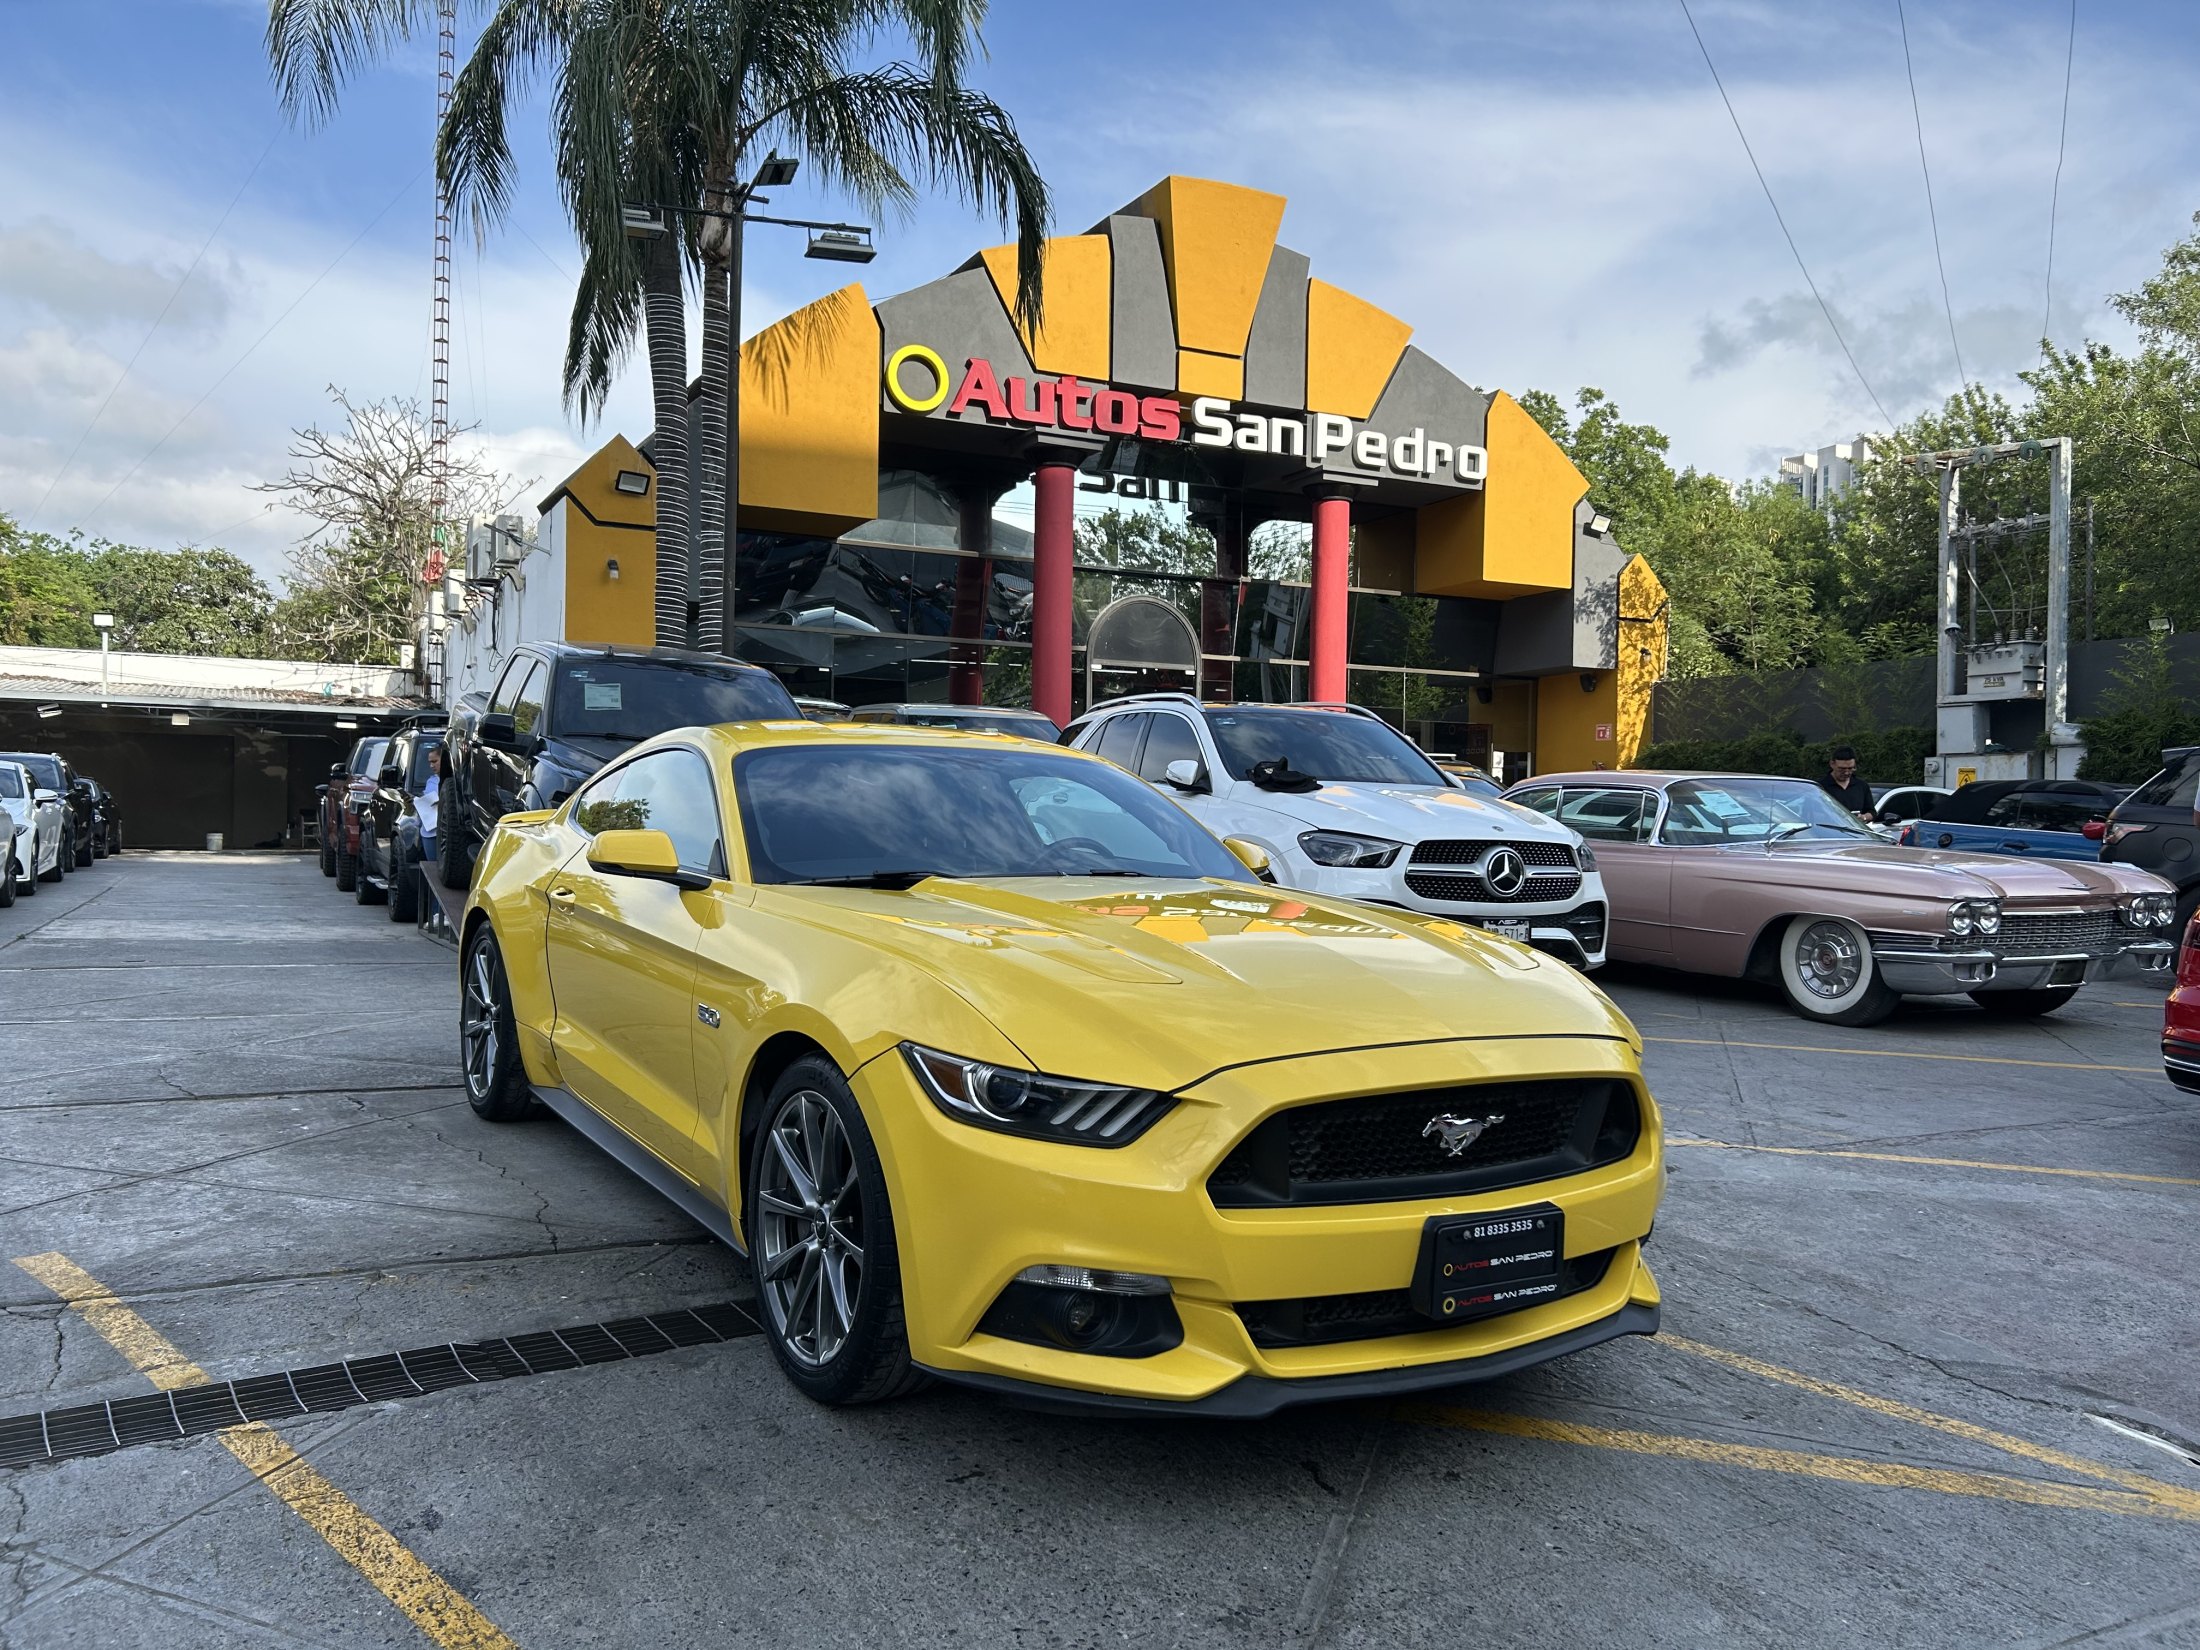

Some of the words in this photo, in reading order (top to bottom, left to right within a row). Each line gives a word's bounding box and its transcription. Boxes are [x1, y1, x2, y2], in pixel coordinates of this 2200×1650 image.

[950, 357, 1181, 441] Autos
[1191, 397, 1304, 456] San
[1308, 412, 1488, 481] Pedro
[1474, 1227, 1486, 1238] 81
[1487, 1223, 1509, 1236] 8335
[1510, 1219, 1533, 1232] 3535
[1454, 1261, 1489, 1271] AUTOS
[1490, 1256, 1514, 1266] SAN
[1515, 1250, 1554, 1261] PEDRO
[1493, 1291, 1517, 1301] SAN
